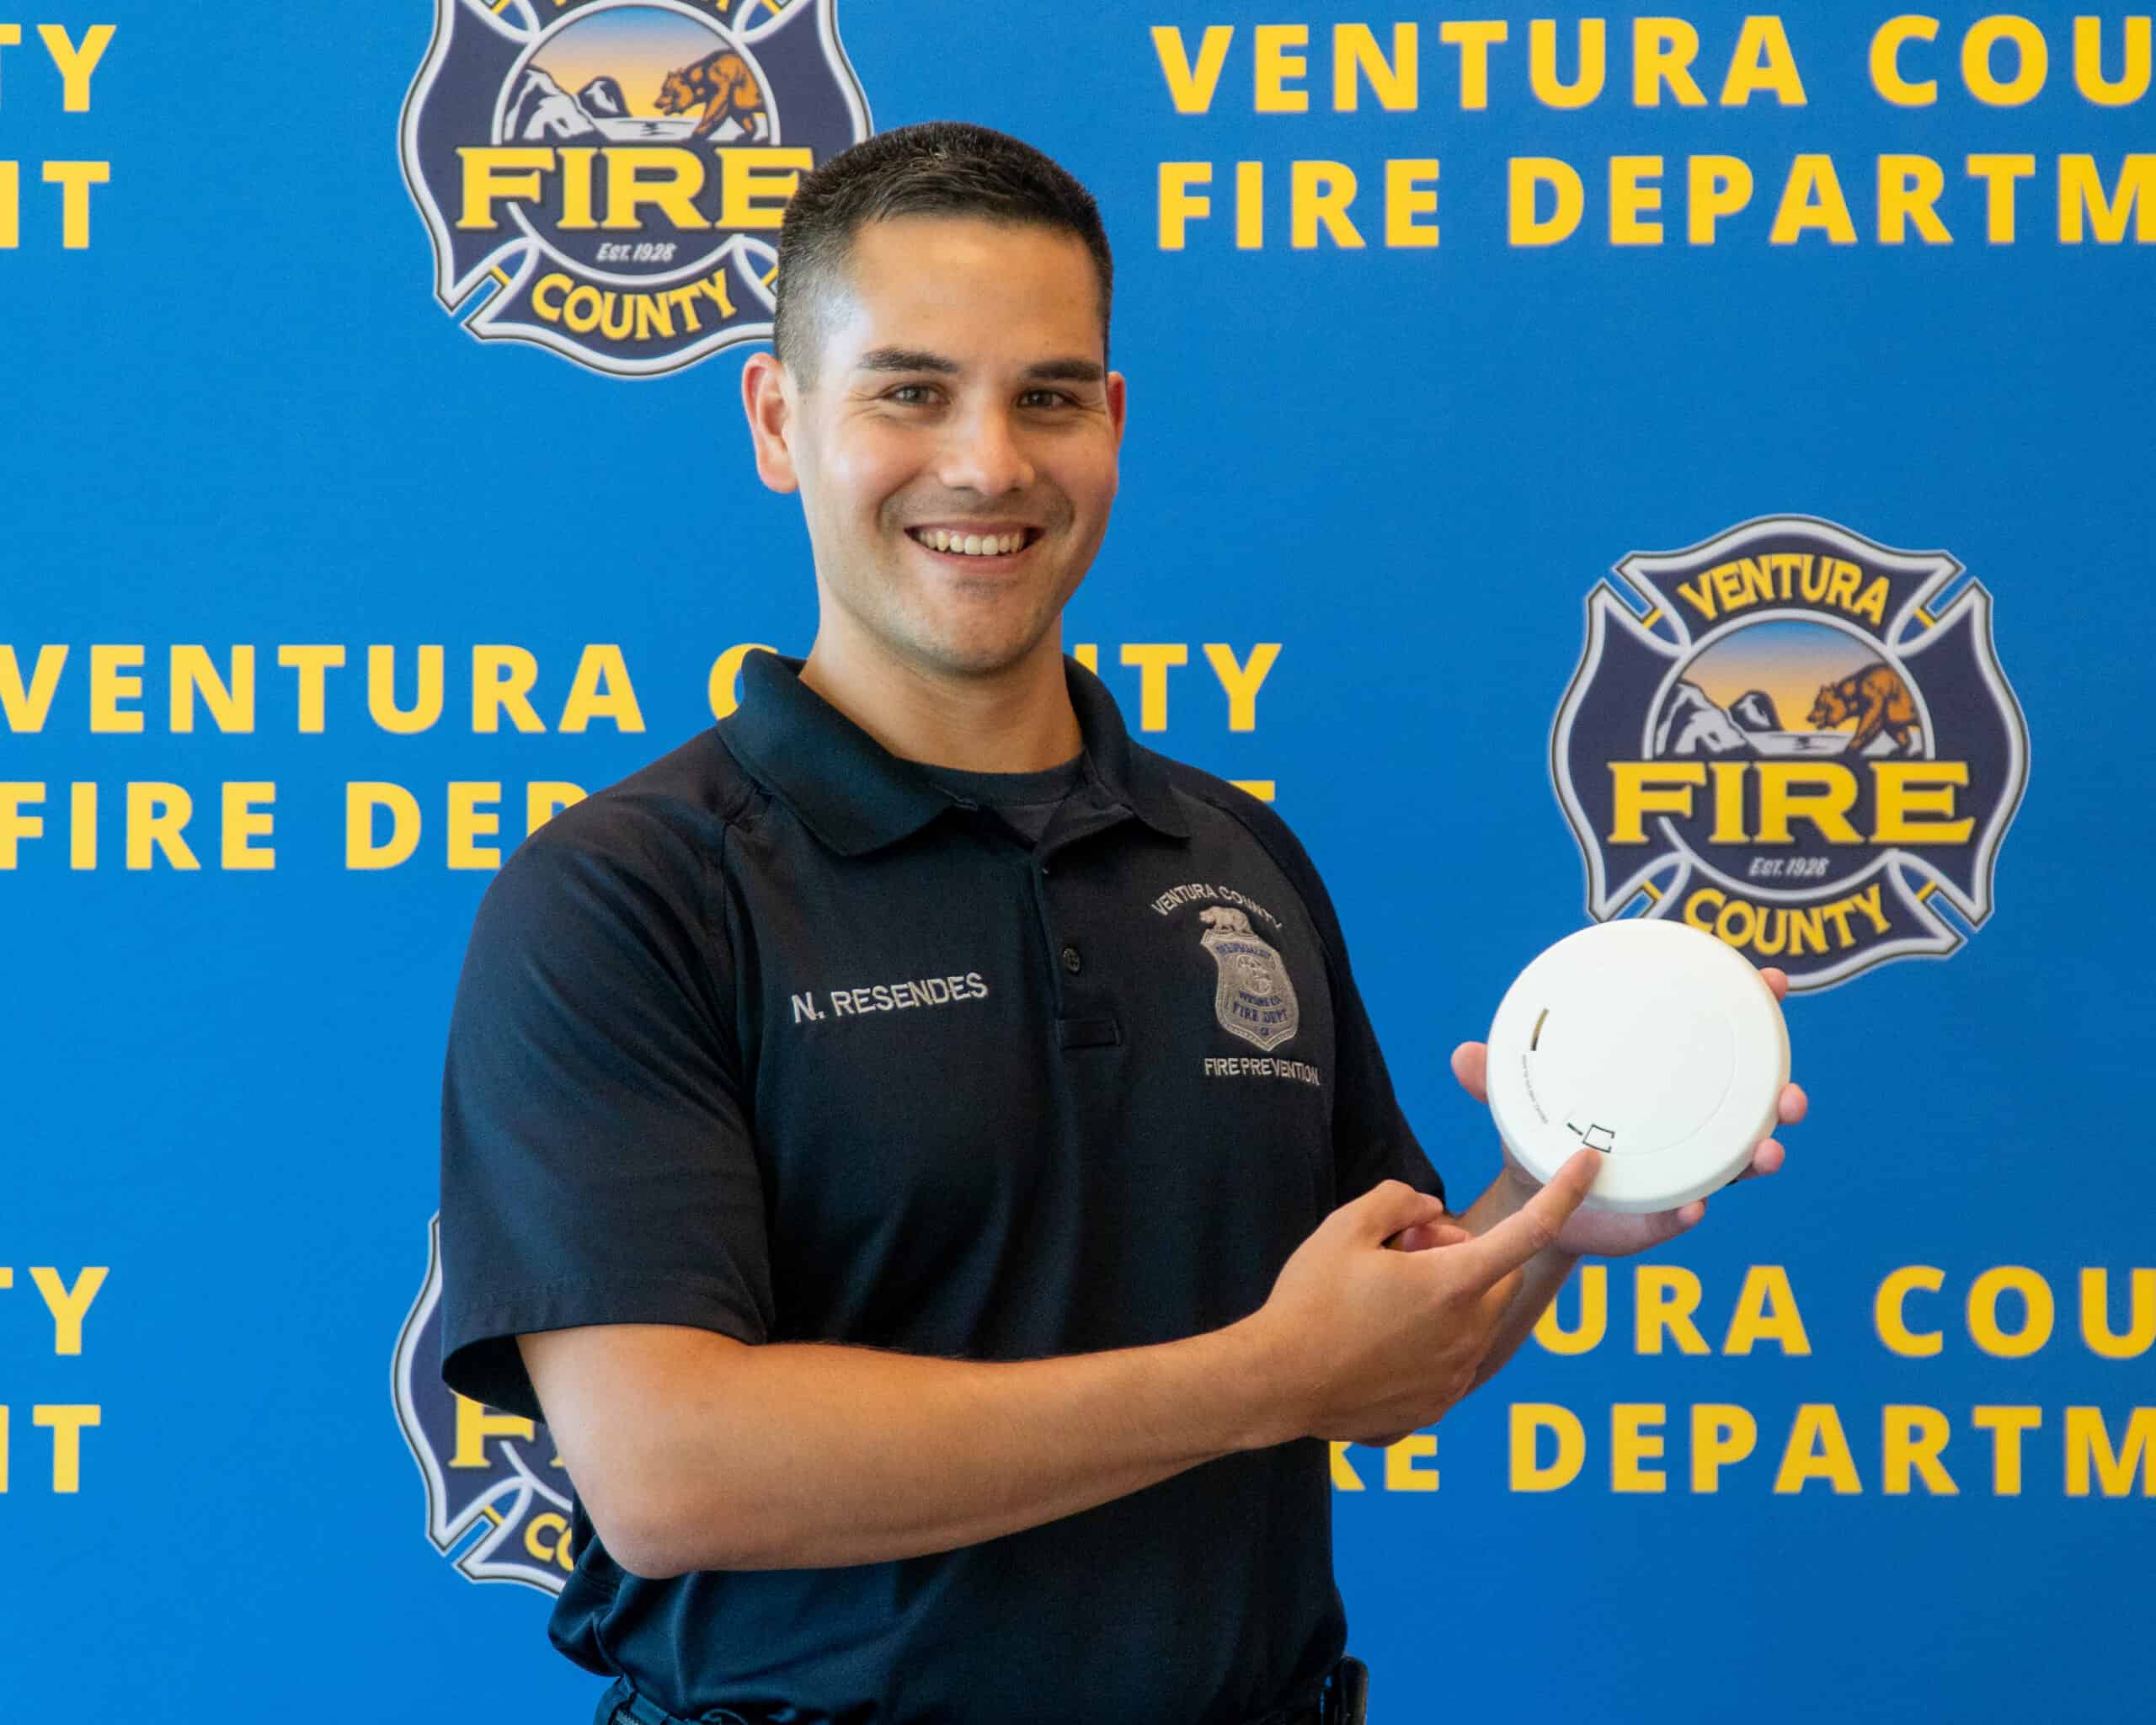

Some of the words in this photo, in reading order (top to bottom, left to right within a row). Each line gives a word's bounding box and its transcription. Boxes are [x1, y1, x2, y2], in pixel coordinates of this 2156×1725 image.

[1151, 15, 1807, 113] VENTURA
[1869, 14, 2153, 106] COU
[456, 146, 815, 230] FIRE
[1159, 158, 1439, 249] FIRE
[1508, 153, 2156, 246] DEPARTM
[632, 242, 677, 262] 1928
[531, 270, 737, 342] COUNTY
[1678, 553, 1891, 627] VENTURA
[0, 644, 645, 733] VENTURA
[0, 782, 277, 870] FIRE
[1606, 761, 1977, 844] FIRE
[1150, 883, 1219, 916] VENTURA
[1785, 856, 1830, 877] 1928
[1683, 882, 1892, 956] COUNTY
[791, 991, 825, 1023] N.
[830, 972, 989, 1017] RESENDES
[1204, 1057, 1240, 1076] FIRE
[1874, 1264, 2156, 1358] COU
[1508, 1402, 2156, 1498] DEPARTM
